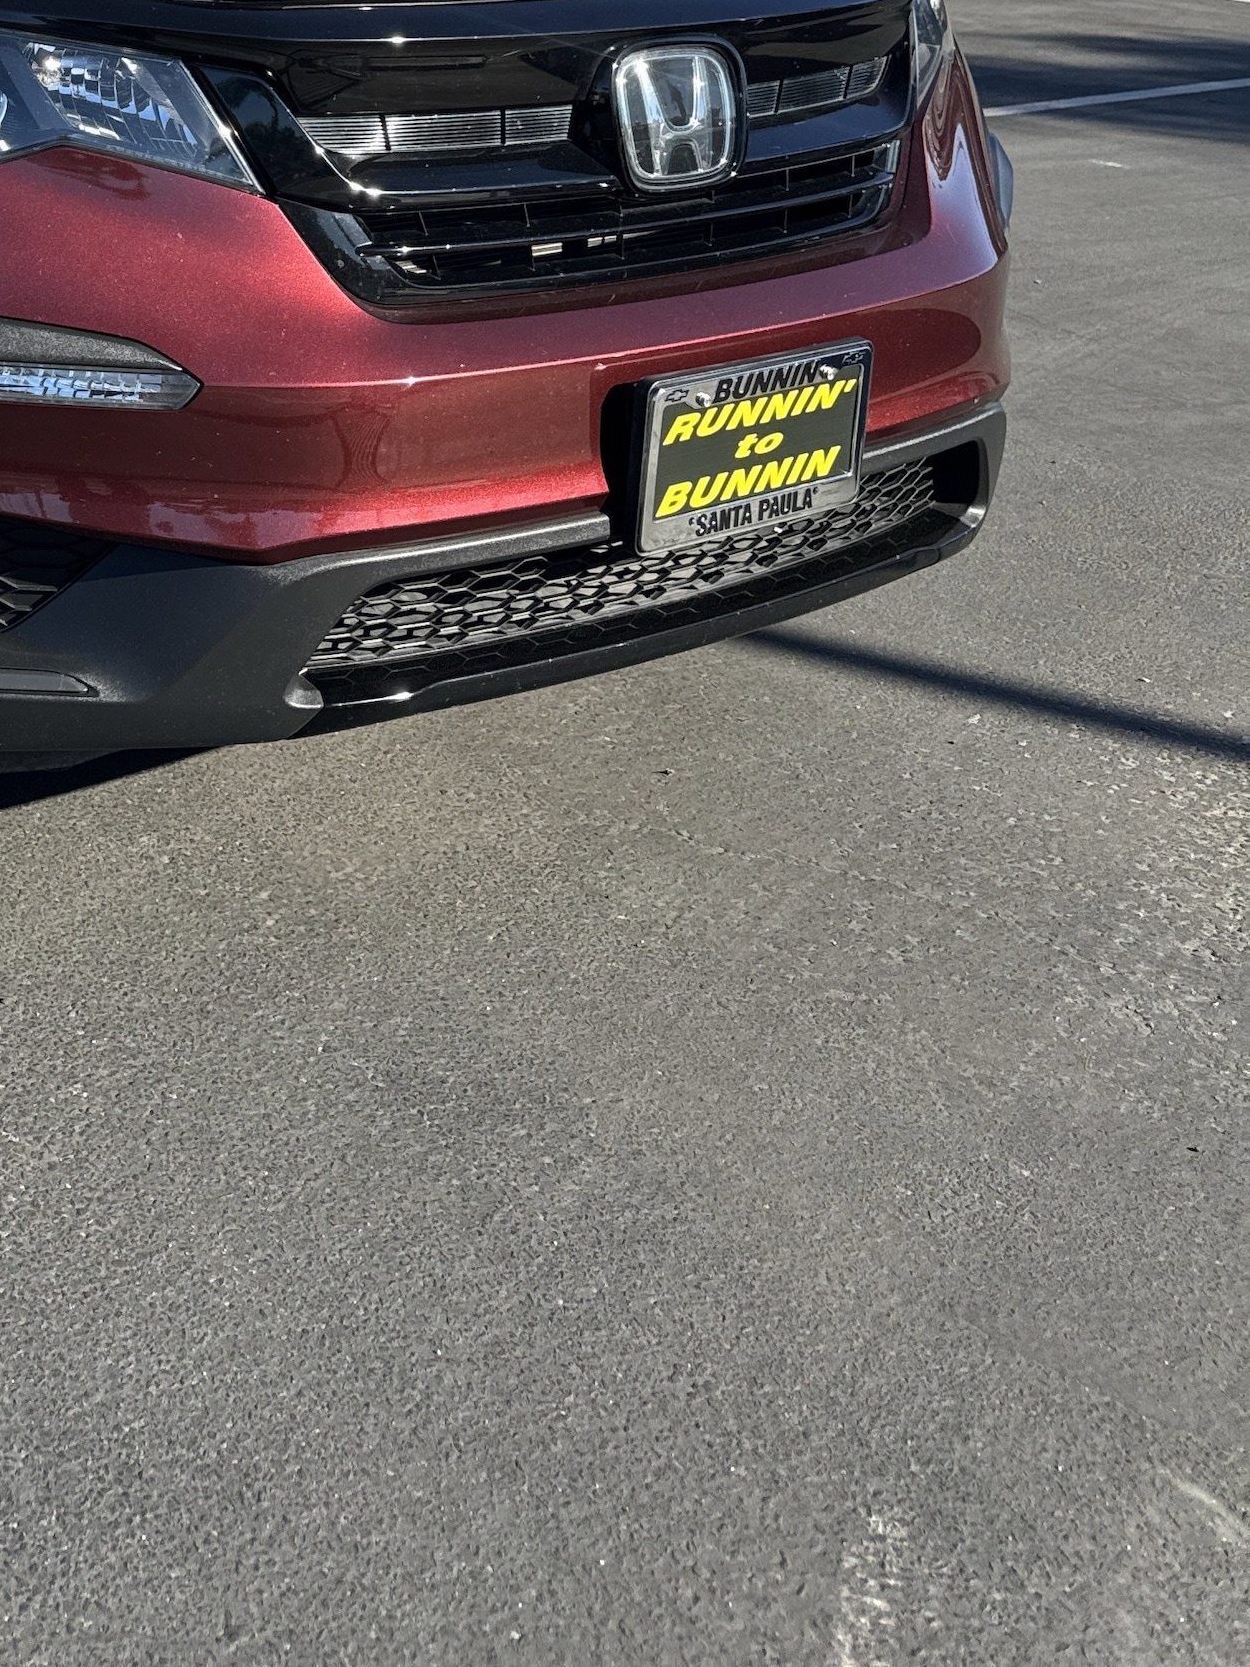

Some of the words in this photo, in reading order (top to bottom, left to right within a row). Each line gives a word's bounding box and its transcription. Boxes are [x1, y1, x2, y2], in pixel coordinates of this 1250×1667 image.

[713, 361, 822, 404] BUNNIN
[734, 432, 784, 459] to
[655, 445, 841, 517] BUNNIN
